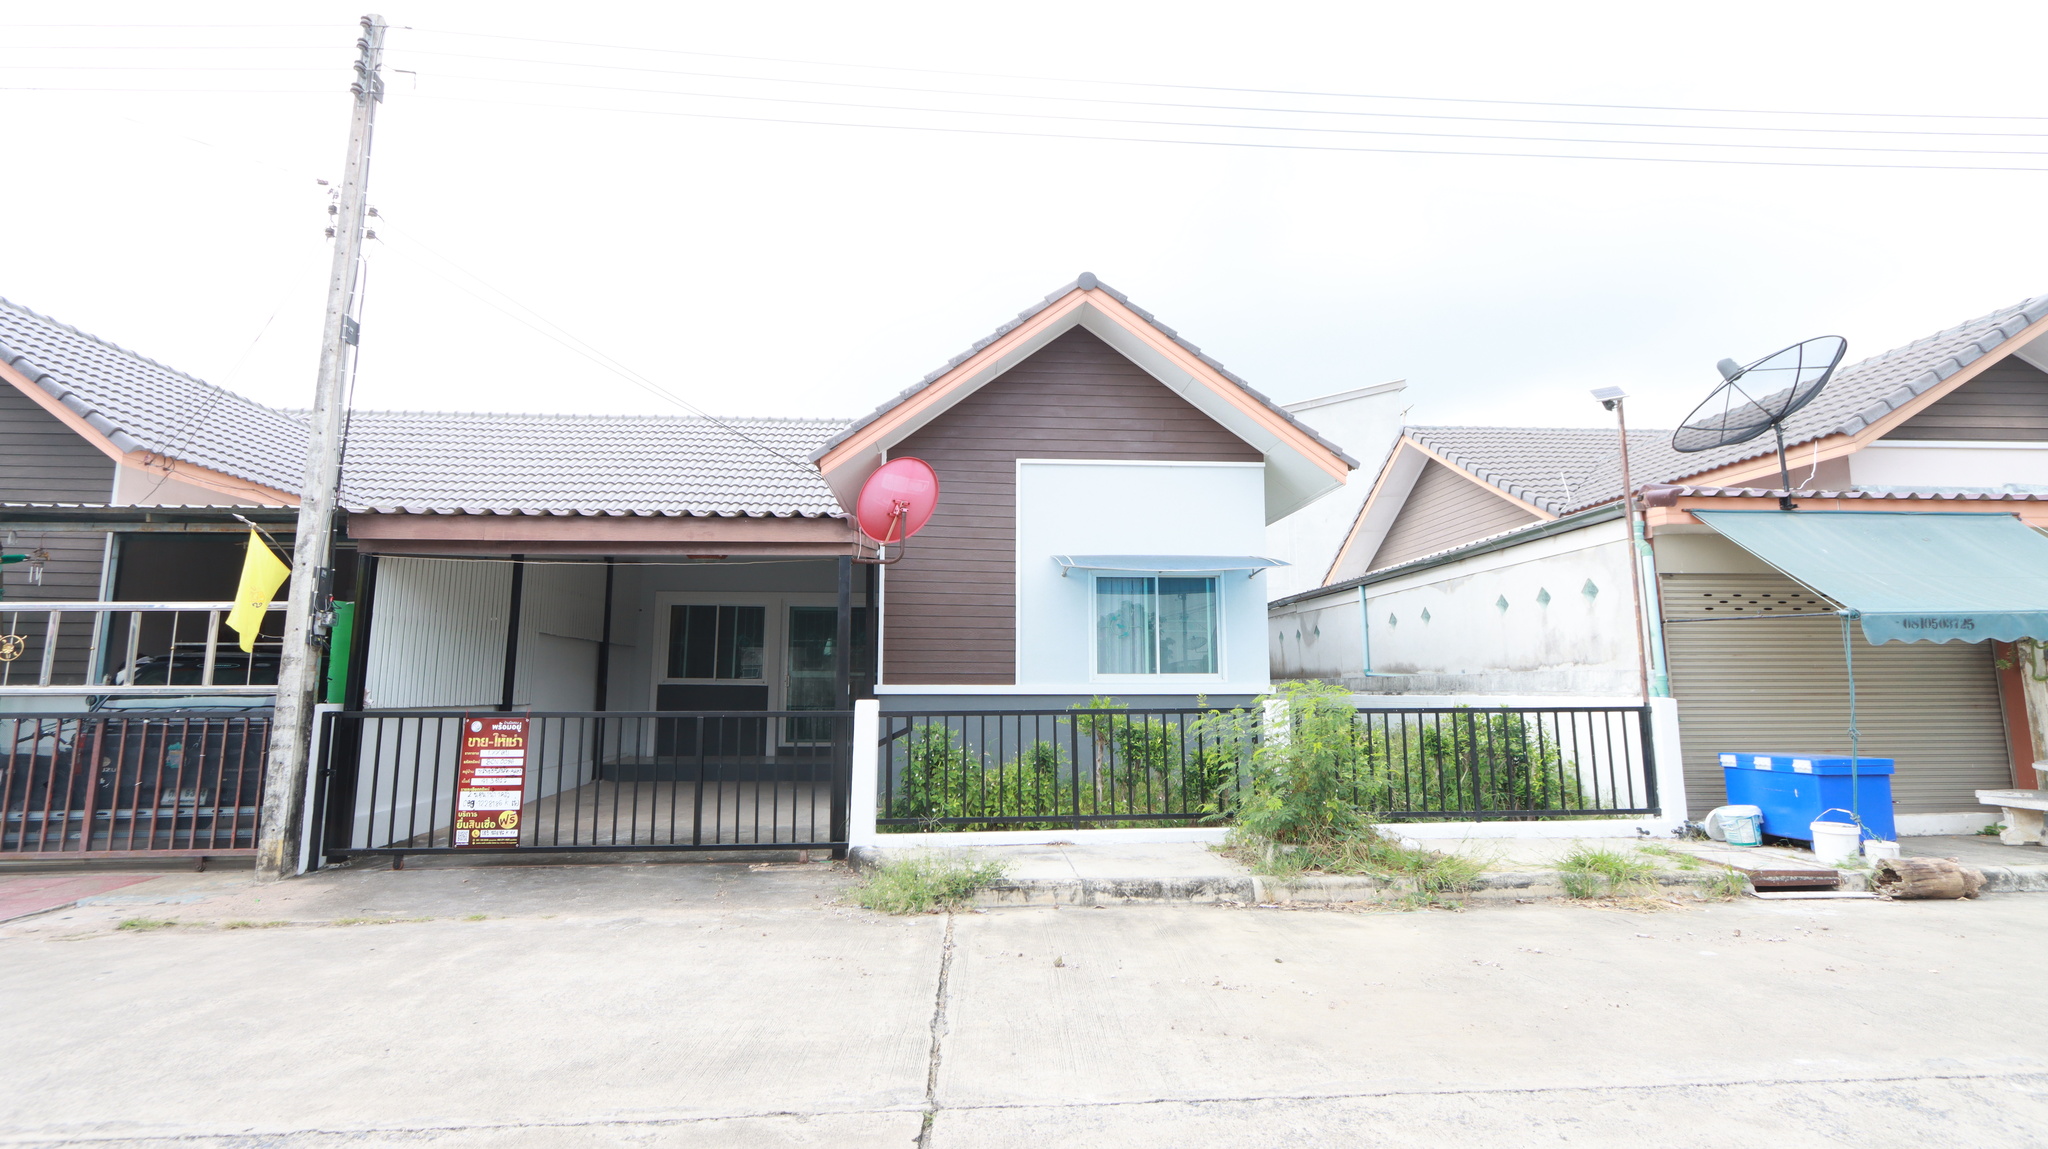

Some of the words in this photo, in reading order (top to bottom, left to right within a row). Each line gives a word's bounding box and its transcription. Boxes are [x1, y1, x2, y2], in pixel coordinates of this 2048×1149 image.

[491, 721, 522, 732] พร้อมอยู่
[467, 733, 523, 747] ขาย-ให้เช่า
[456, 817, 496, 829] ยื่นสินเชื่อ
[500, 812, 516, 825] ฟรี
